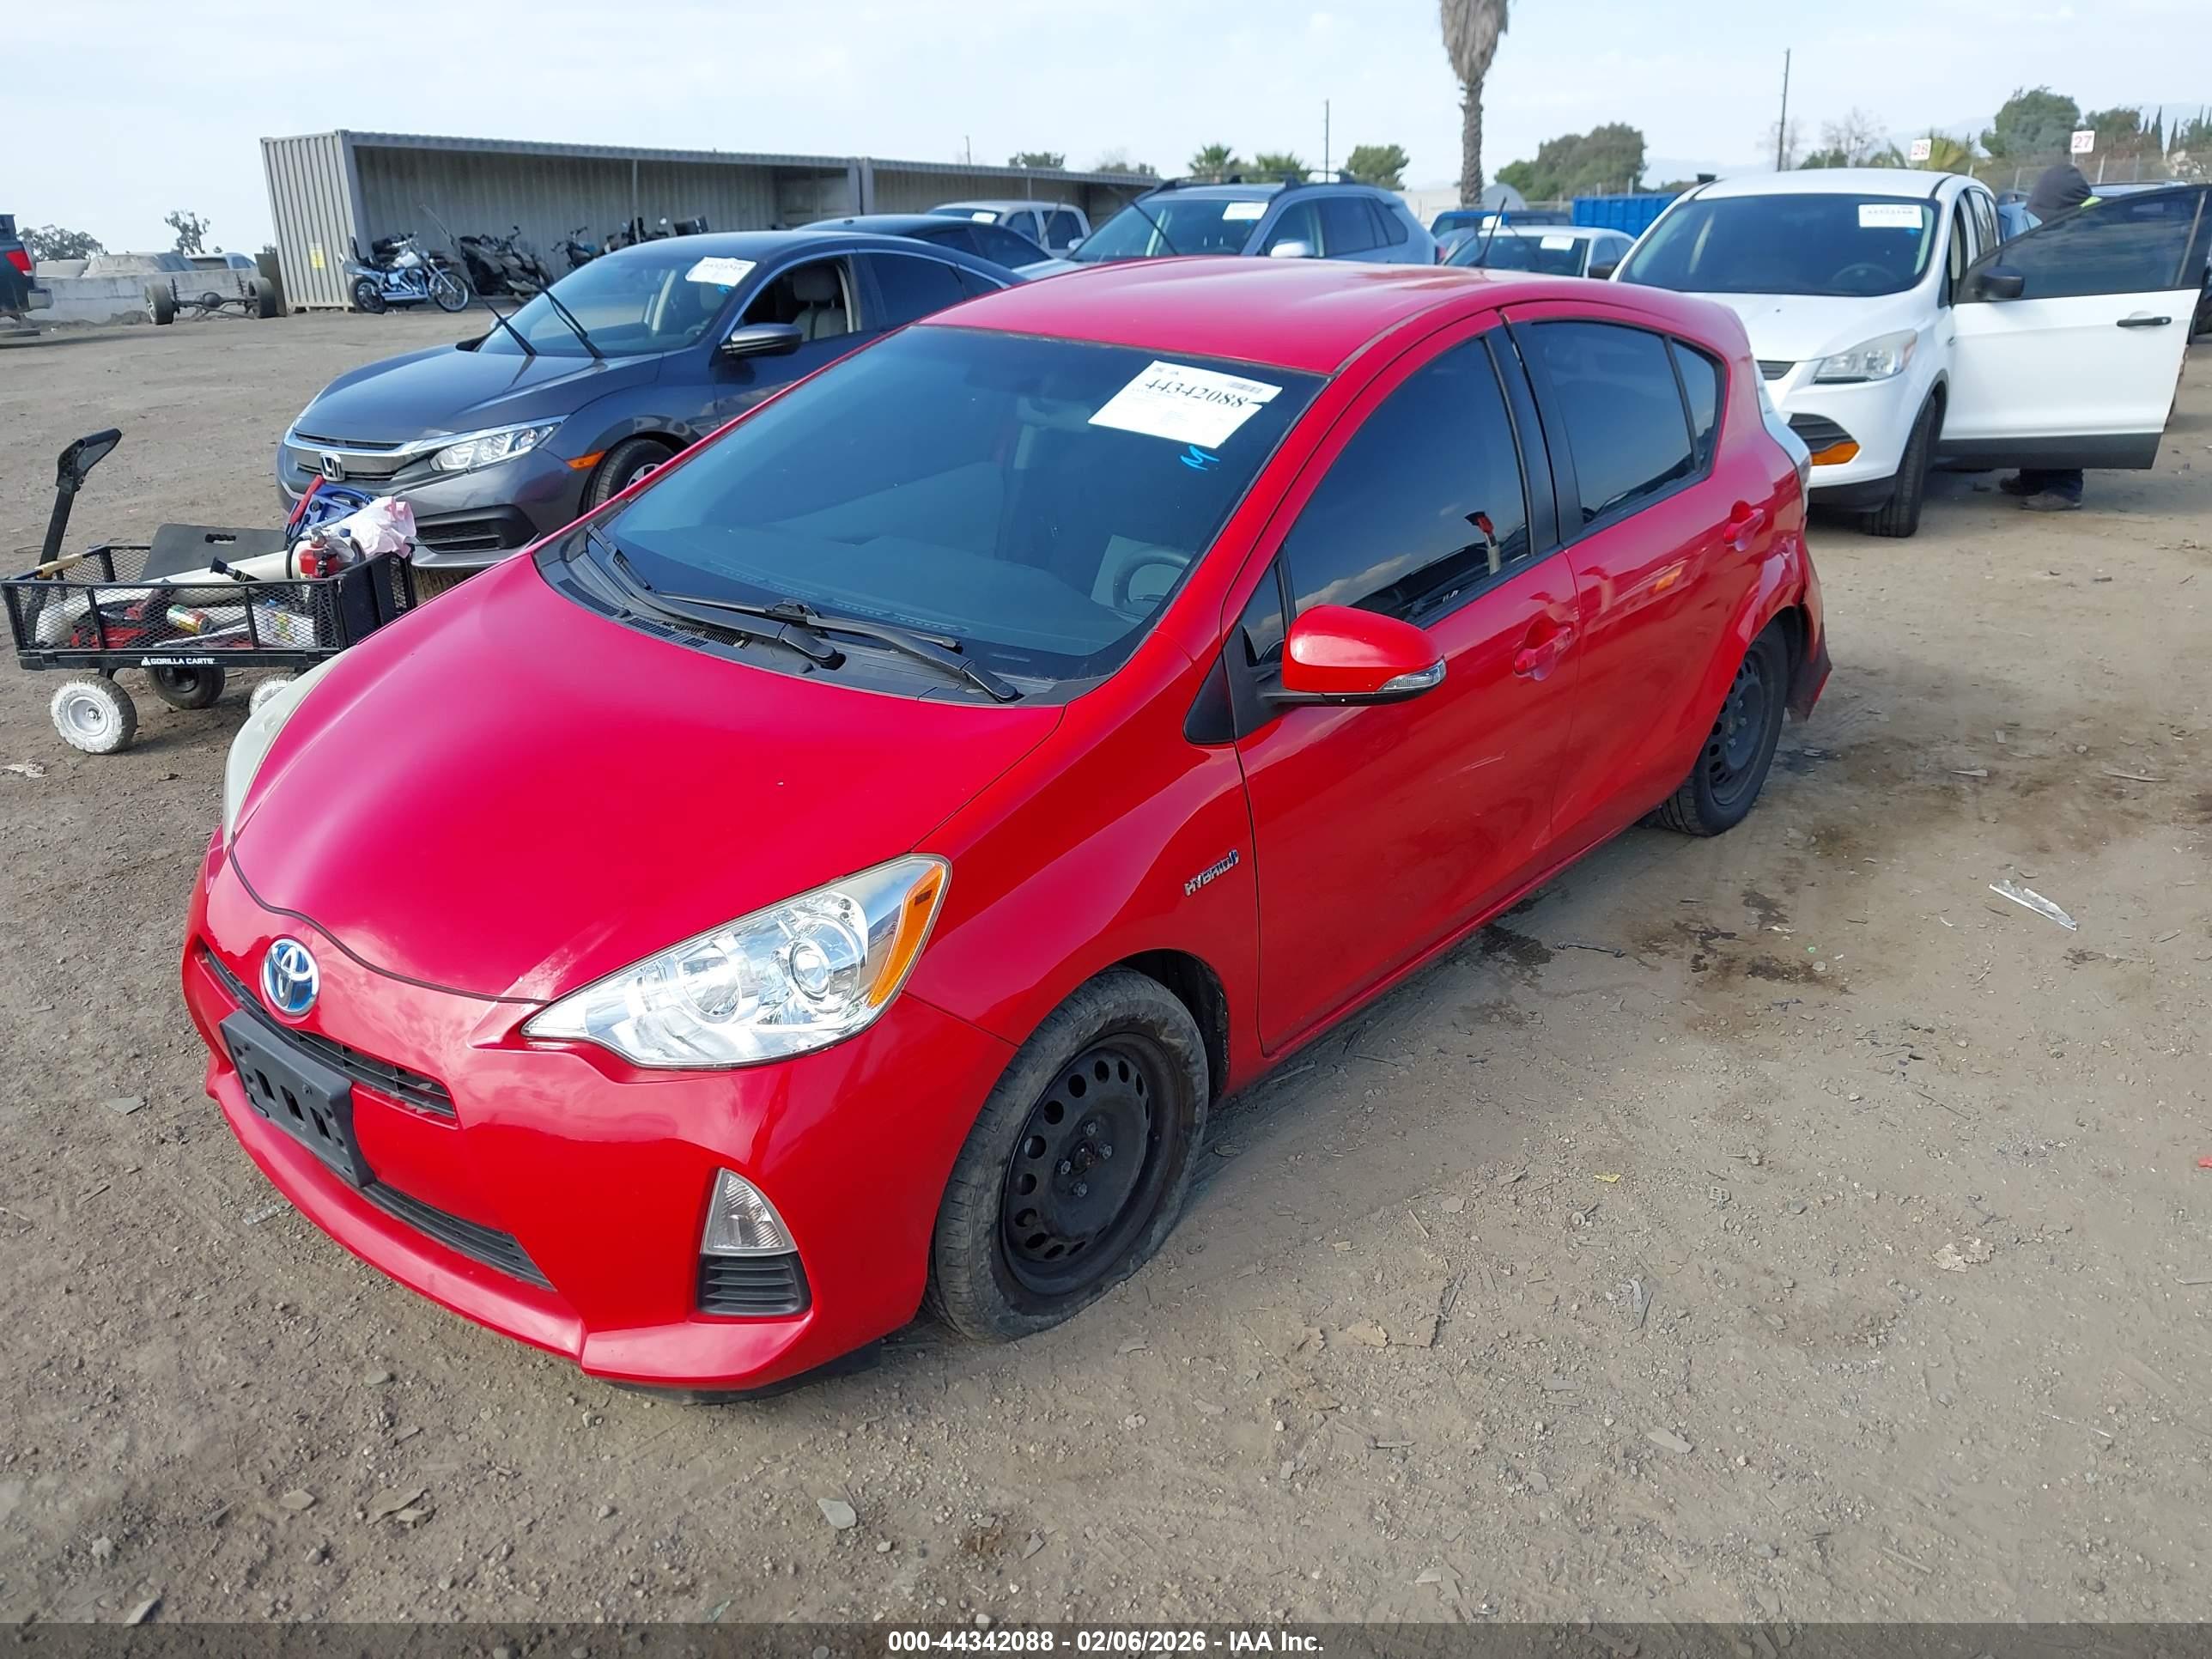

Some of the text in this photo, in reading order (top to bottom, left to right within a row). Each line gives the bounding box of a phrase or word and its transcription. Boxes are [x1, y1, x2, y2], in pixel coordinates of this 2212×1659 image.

[2074, 135, 2093, 148] 27
[1145, 379, 1249, 408] 44342088
[1184, 856, 1231, 896] HYBRID
